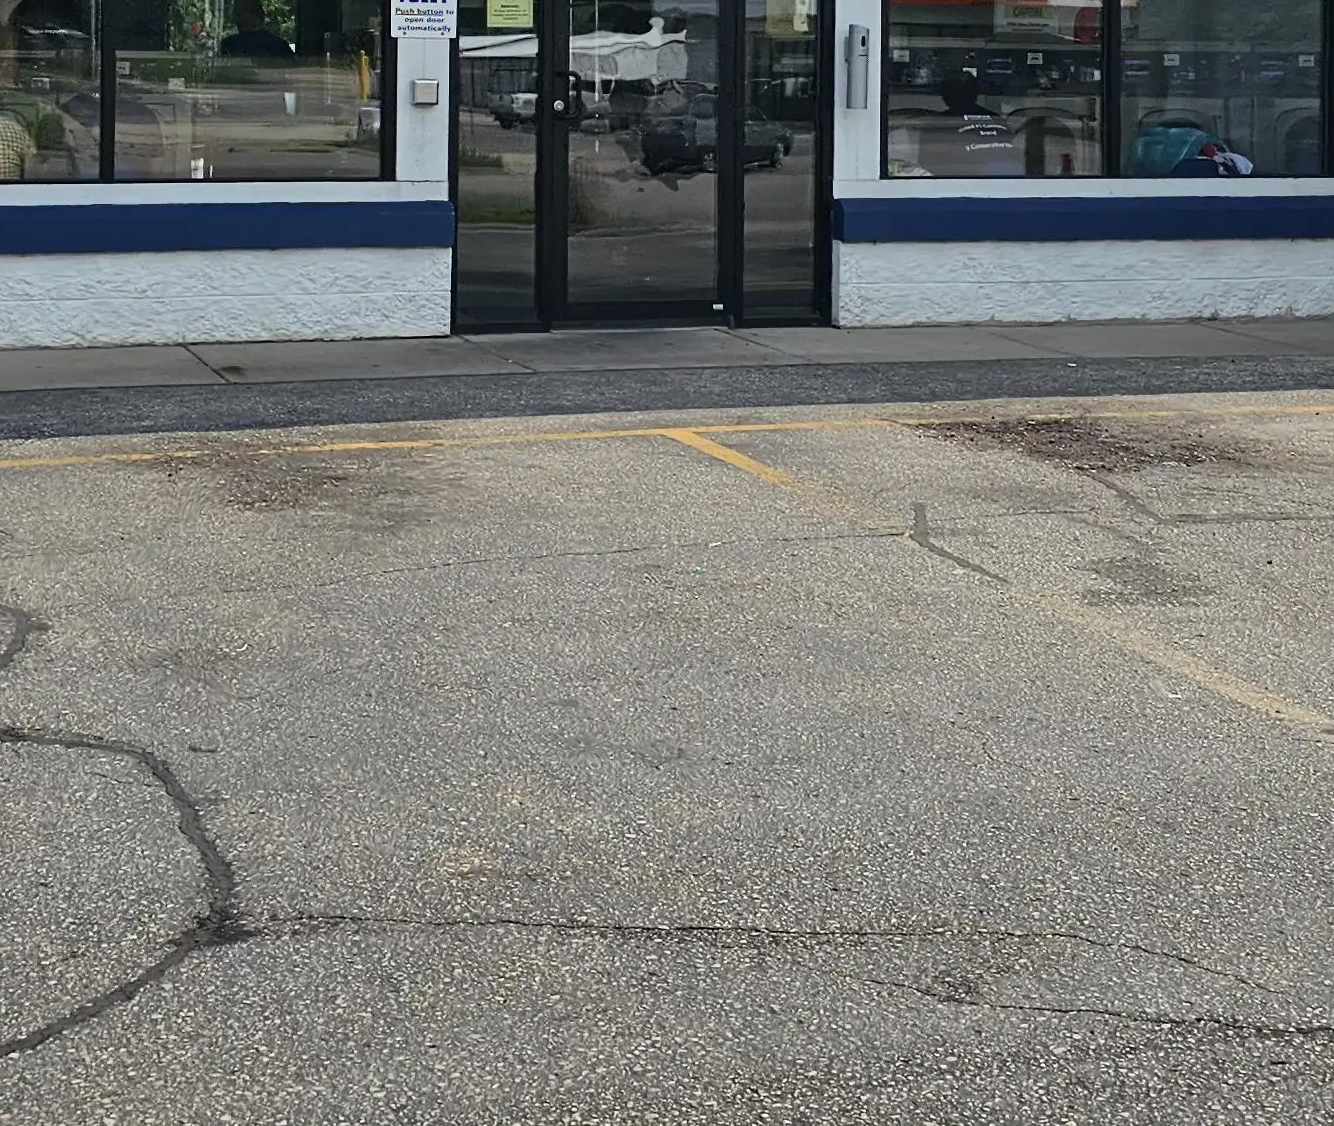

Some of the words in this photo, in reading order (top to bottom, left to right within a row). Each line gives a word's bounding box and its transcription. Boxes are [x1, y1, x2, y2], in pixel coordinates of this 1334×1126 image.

[395, 7, 415, 15] Push
[417, 7, 444, 15] button
[397, 25, 451, 33] automatically
